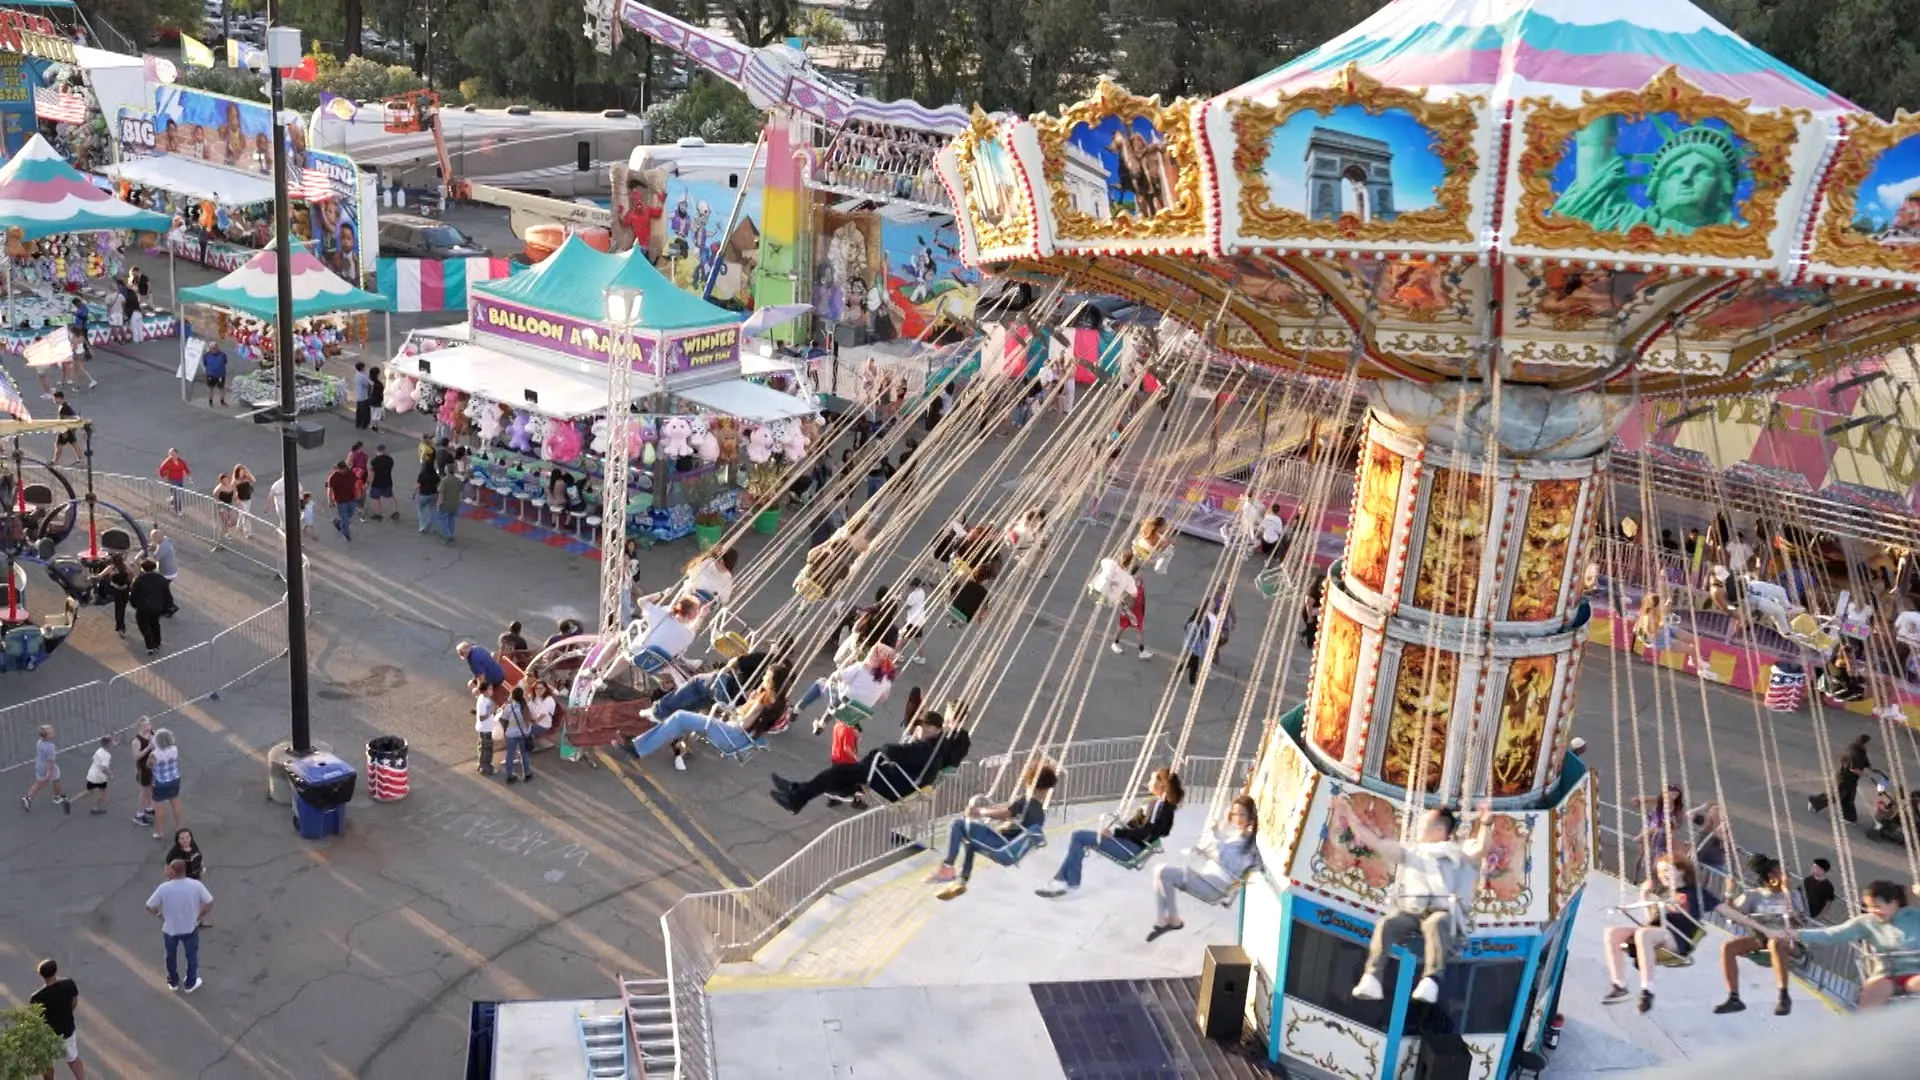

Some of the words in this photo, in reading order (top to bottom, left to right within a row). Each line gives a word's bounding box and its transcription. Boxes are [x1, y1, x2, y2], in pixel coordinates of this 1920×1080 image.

[122, 118, 156, 147] BIG
[488, 306, 565, 342] BALLOON
[683, 328, 736, 356] WINNER
[690, 353, 714, 367] EVERY
[715, 350, 731, 360] TIME
